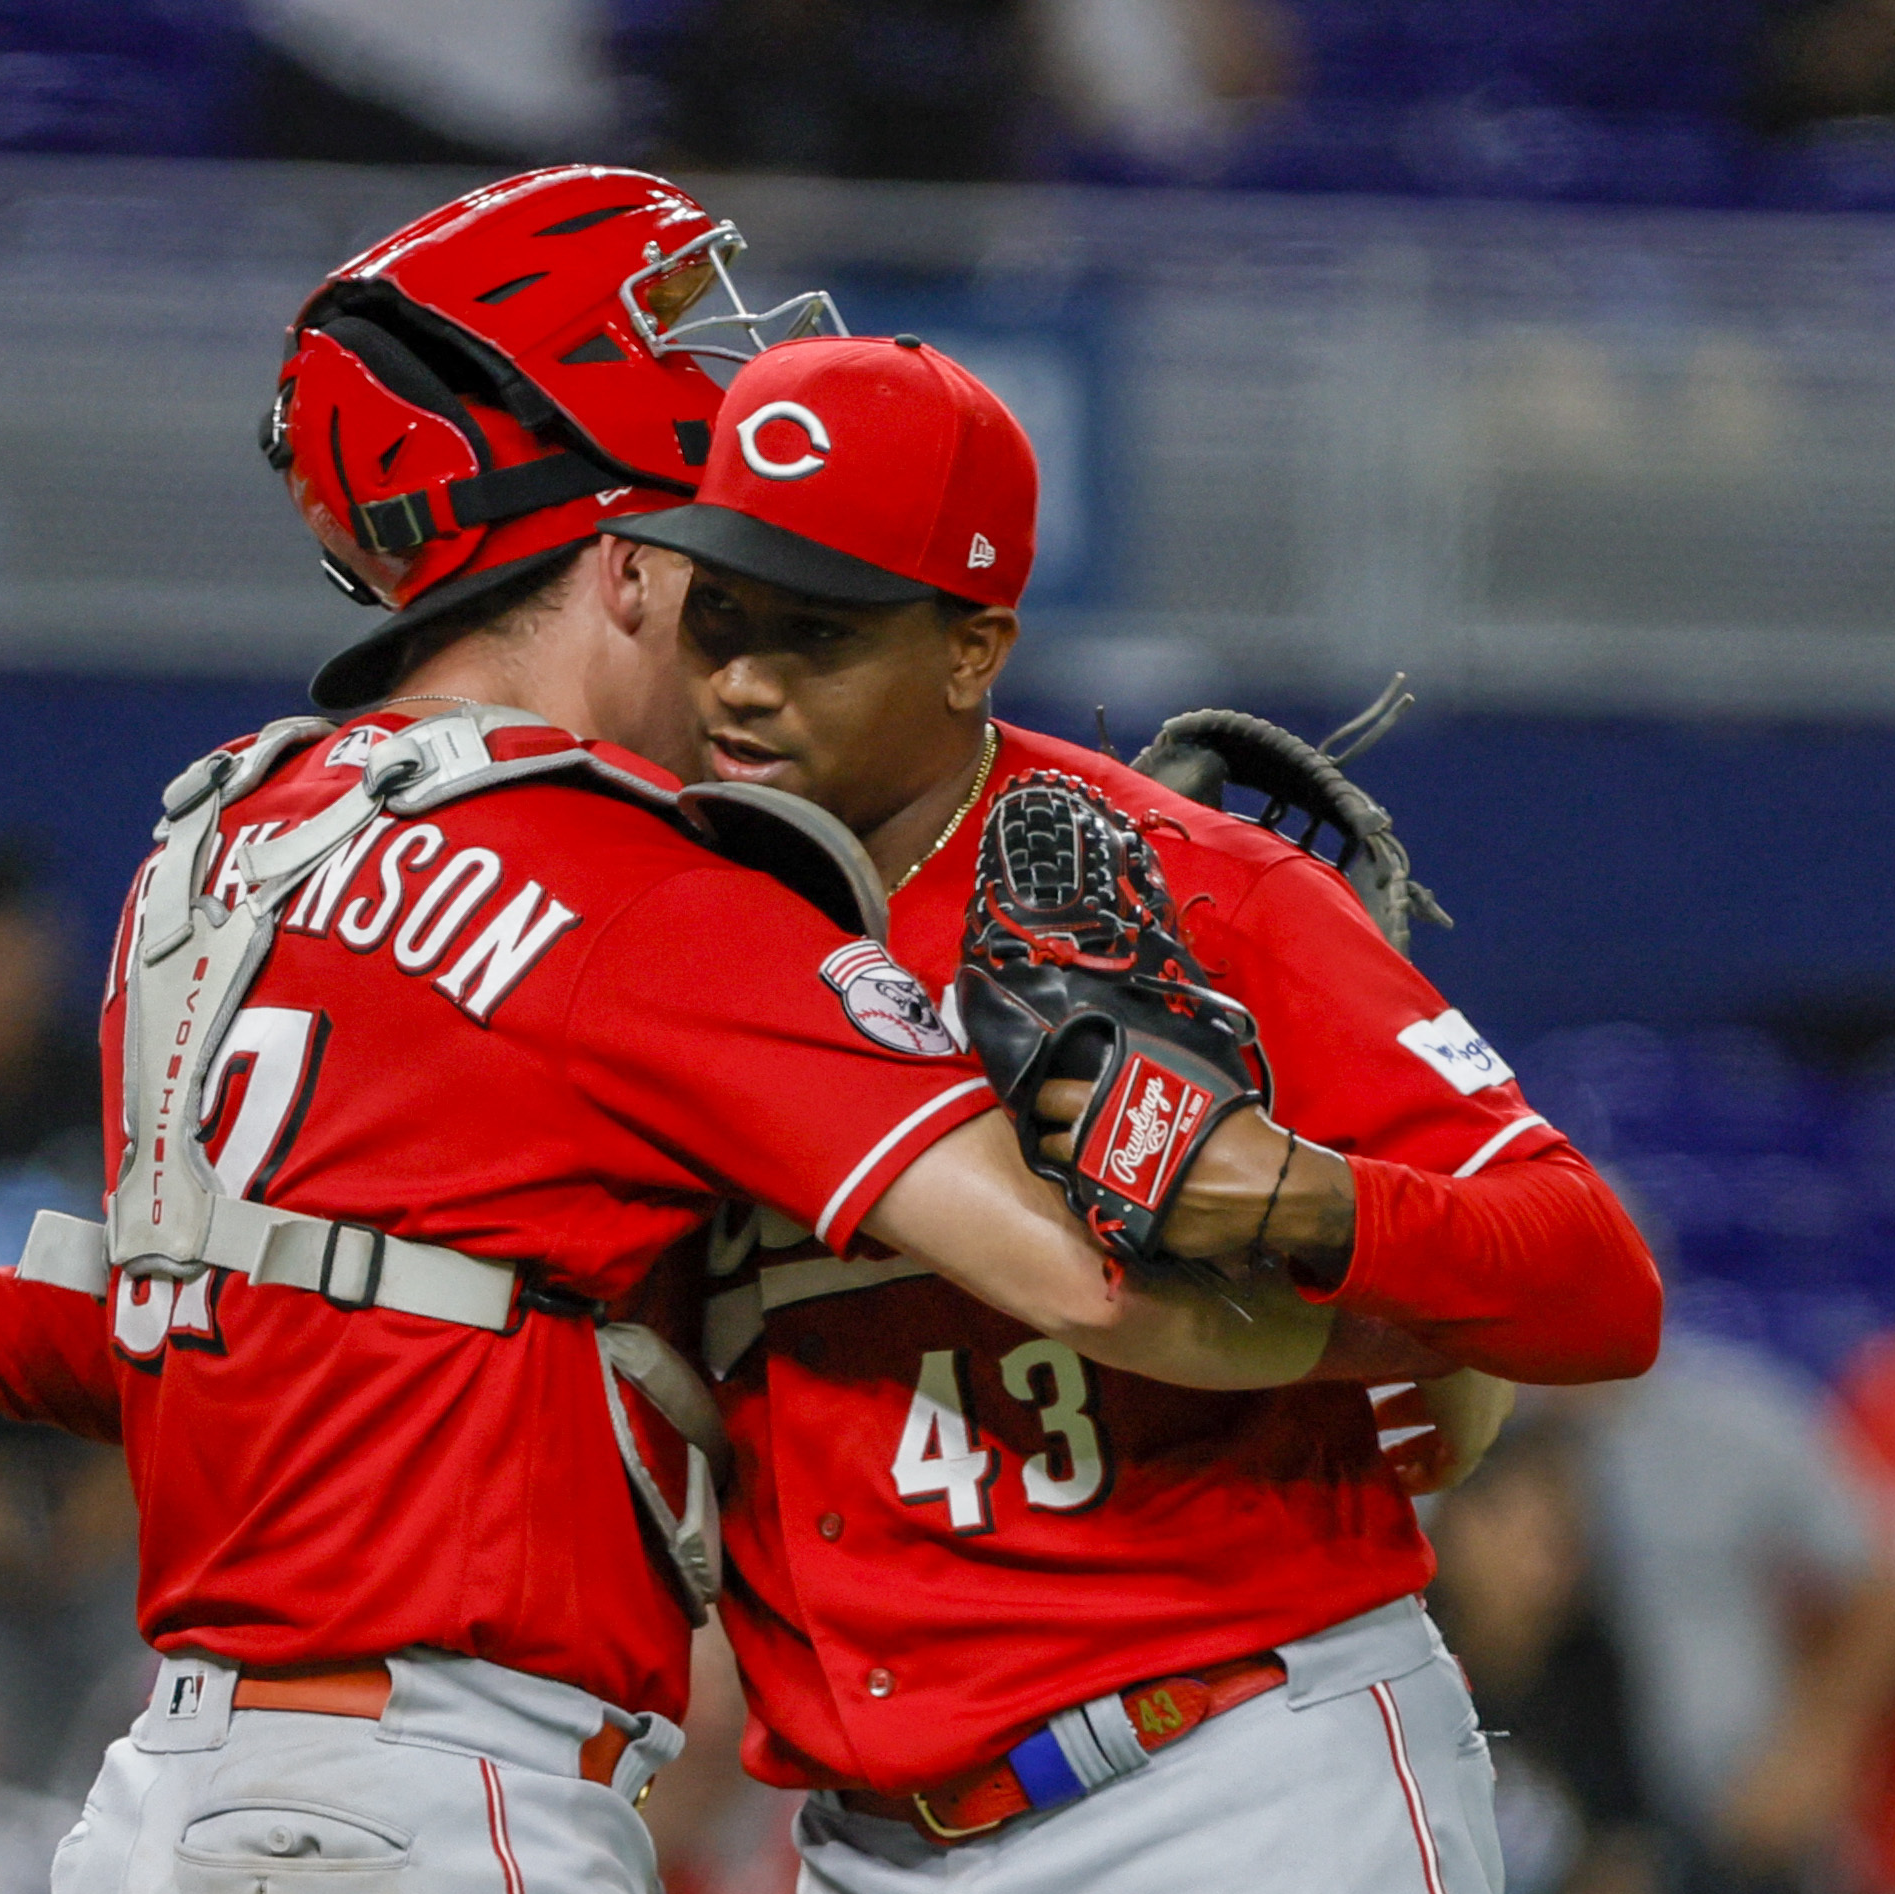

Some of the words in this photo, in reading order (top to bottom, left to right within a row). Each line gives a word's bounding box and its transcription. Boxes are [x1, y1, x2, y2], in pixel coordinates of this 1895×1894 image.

[735, 400, 832, 482] C
[1110, 1077, 1172, 1184] Rawlings
[891, 1338, 1112, 1532] 43
[1139, 1690, 1183, 1735] 43
